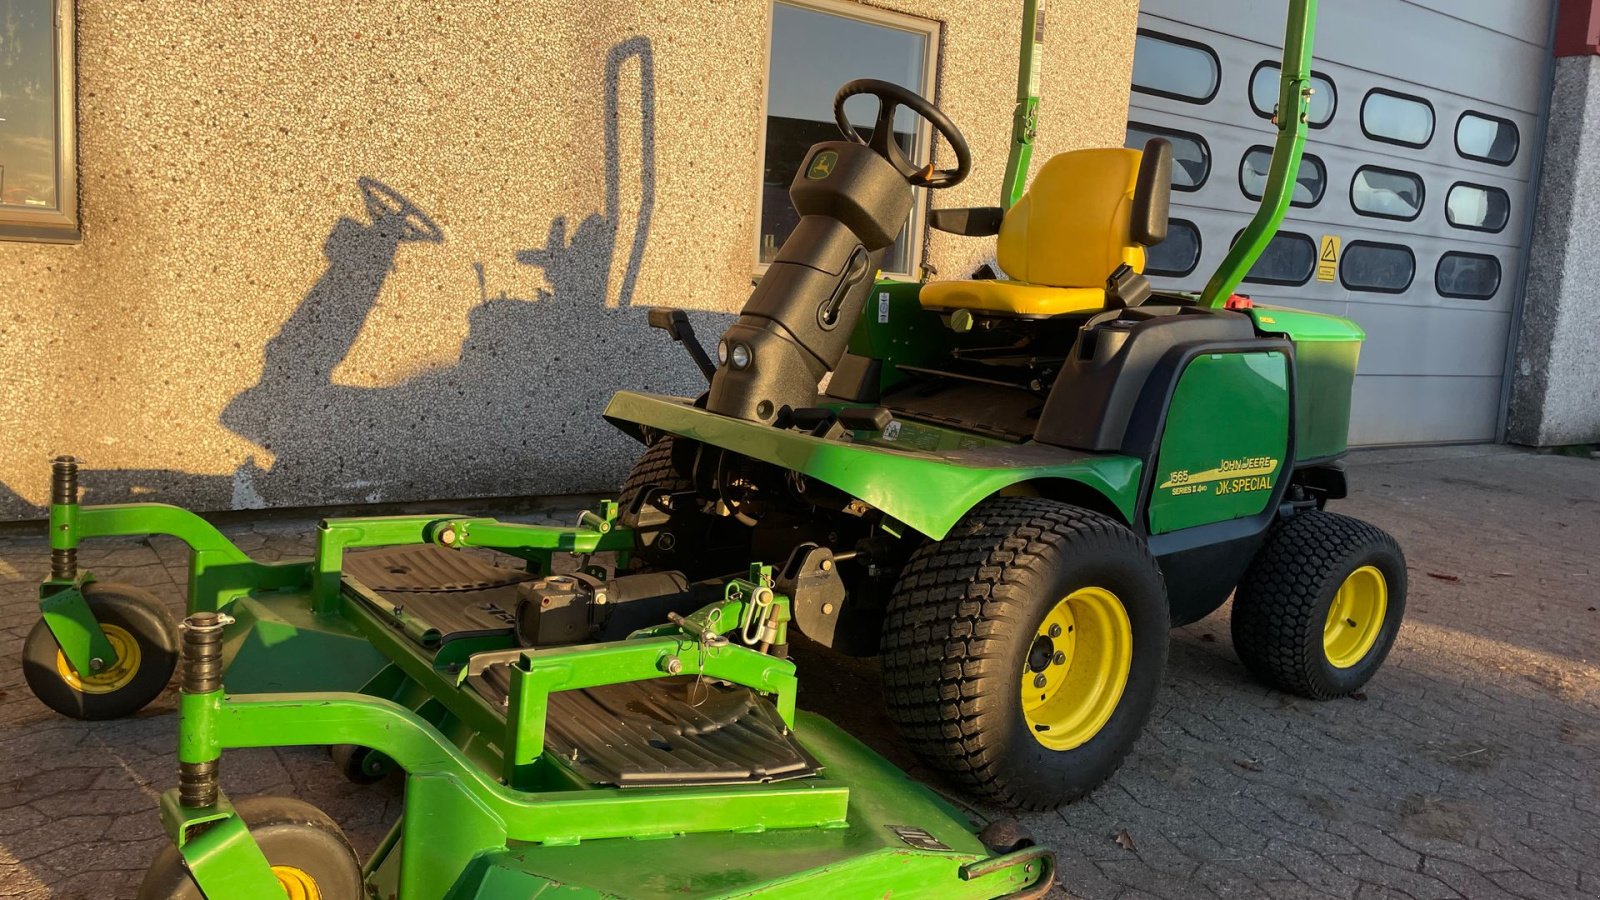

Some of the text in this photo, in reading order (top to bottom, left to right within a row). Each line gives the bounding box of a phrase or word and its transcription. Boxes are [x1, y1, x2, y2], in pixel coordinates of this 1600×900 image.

[1218, 459, 1241, 471] JOHN
[1170, 470, 1188, 483] 1565
[1172, 485, 1191, 496] SERIES
